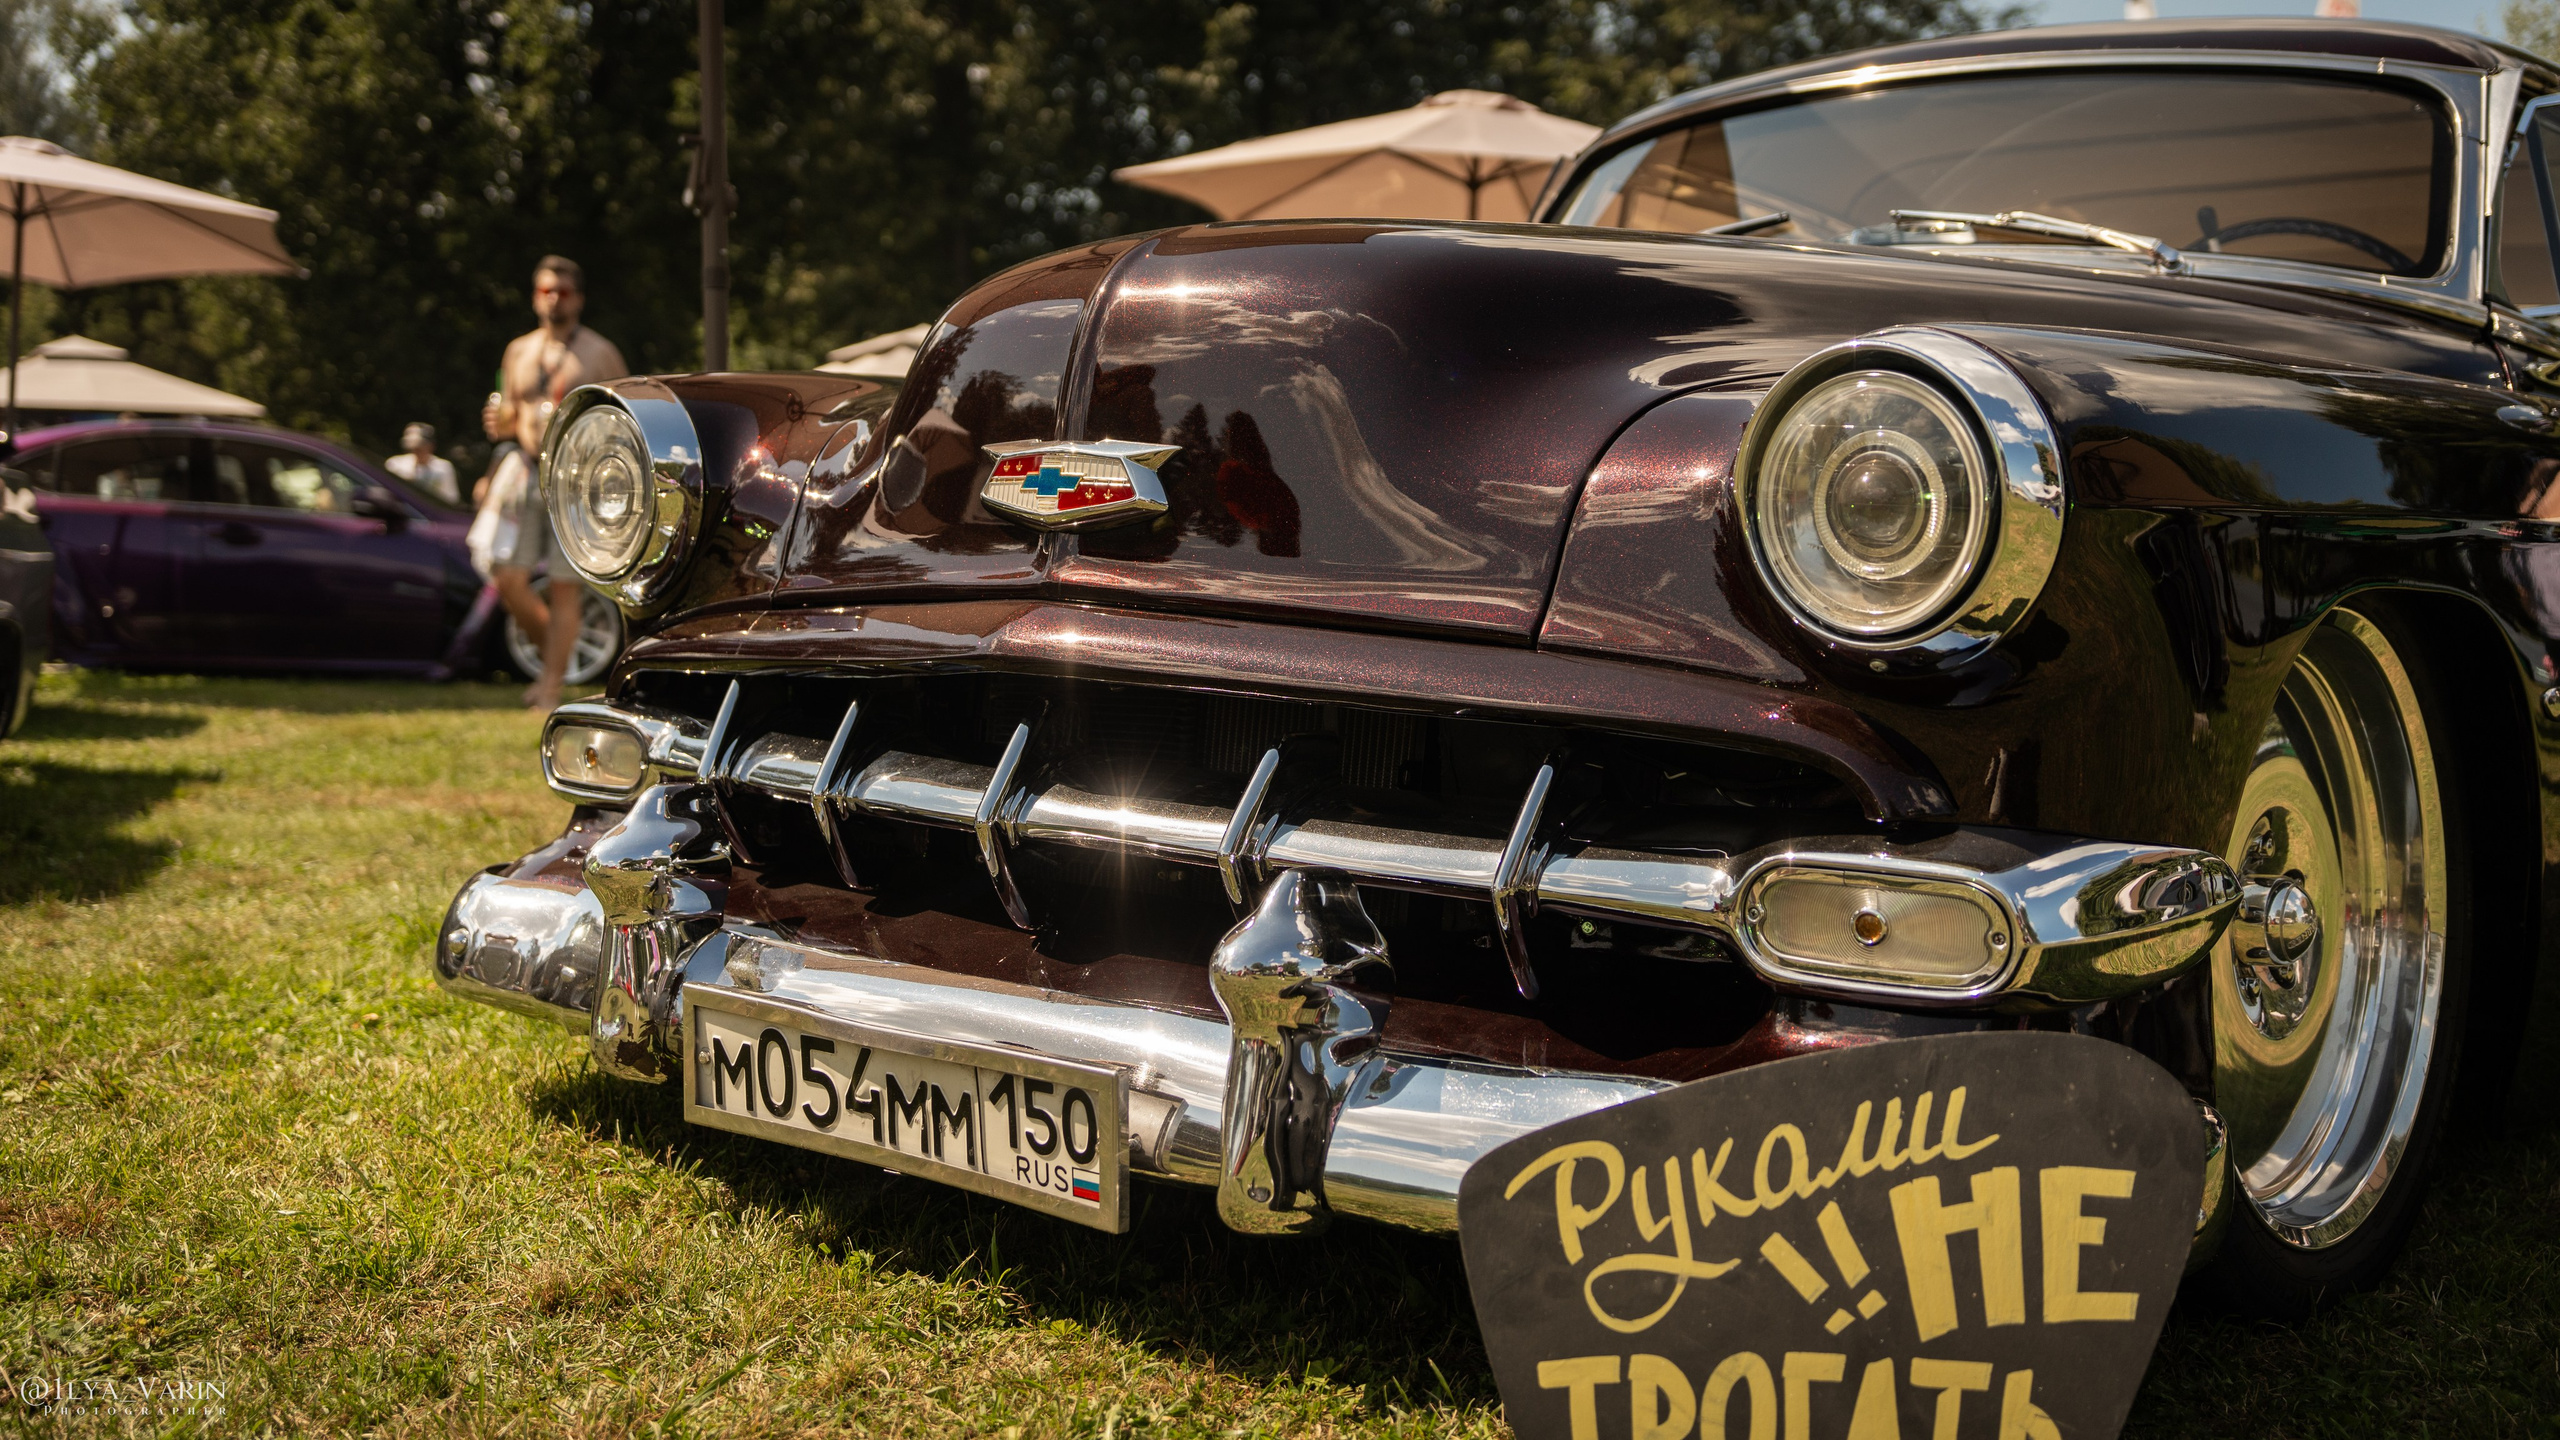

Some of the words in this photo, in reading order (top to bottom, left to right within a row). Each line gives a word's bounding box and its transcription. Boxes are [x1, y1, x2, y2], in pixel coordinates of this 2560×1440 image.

[988, 1073, 1098, 1164] 150
[1016, 1155, 1070, 1193] RUS
[1889, 1165, 2140, 1342] НЕ
